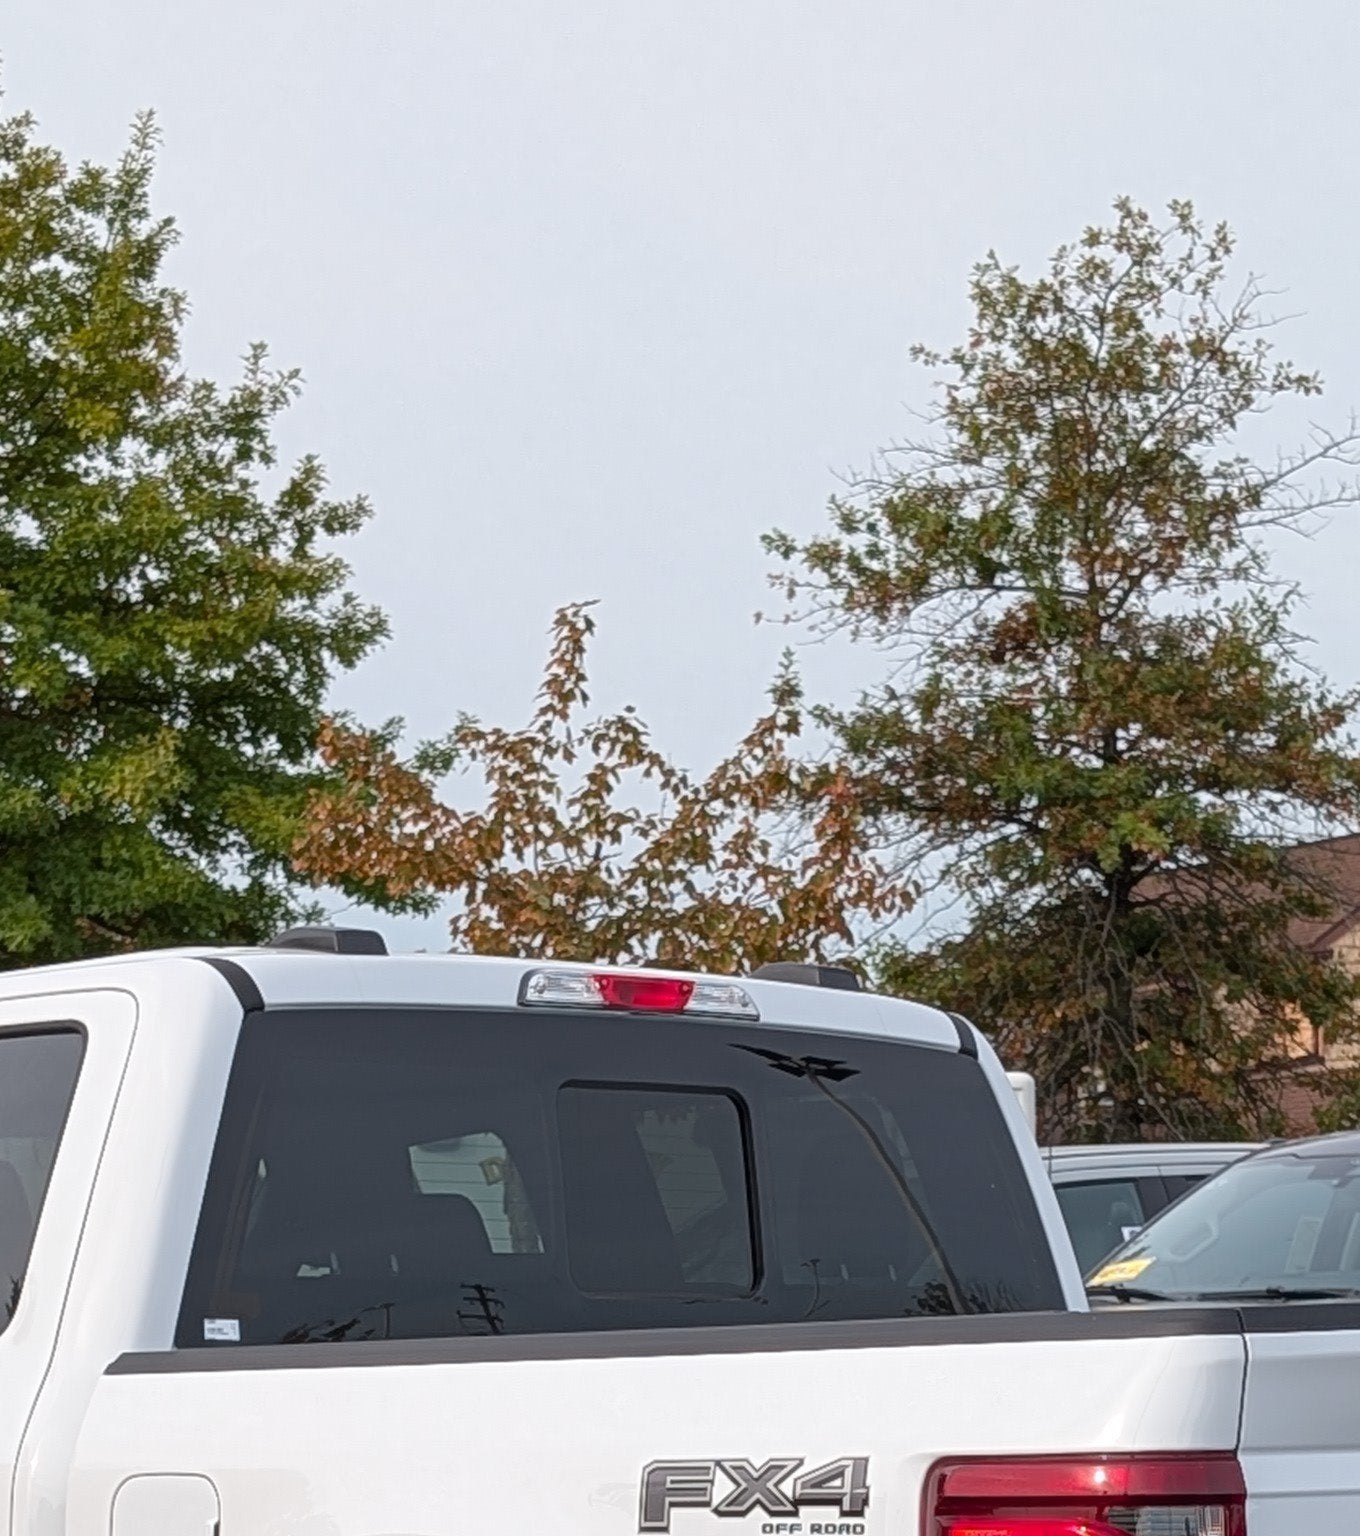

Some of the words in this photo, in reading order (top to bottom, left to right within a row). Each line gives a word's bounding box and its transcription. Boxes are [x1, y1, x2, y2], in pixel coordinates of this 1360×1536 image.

[638, 1457, 870, 1535] FX4
[761, 1523, 803, 1535] OFF
[809, 1523, 866, 1535] ROAD
